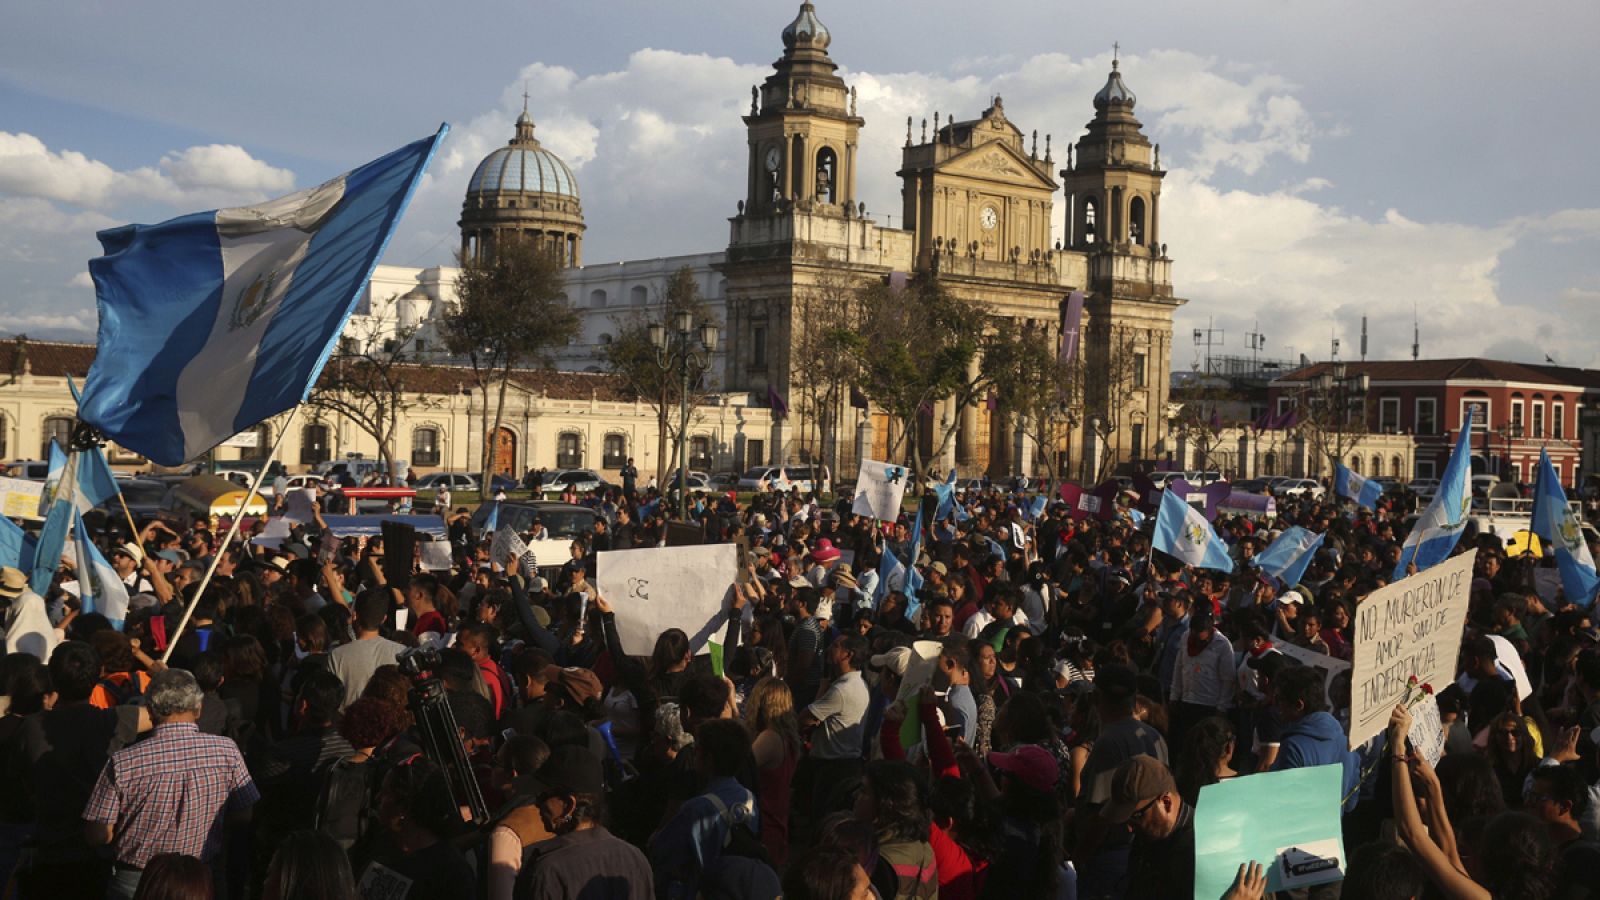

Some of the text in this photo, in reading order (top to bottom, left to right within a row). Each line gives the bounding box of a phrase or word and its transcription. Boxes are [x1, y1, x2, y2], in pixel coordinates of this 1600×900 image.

[1359, 569, 1465, 644] NO MURIERON DE
[1374, 632, 1403, 670] AMOR
[1434, 607, 1449, 632] DE
